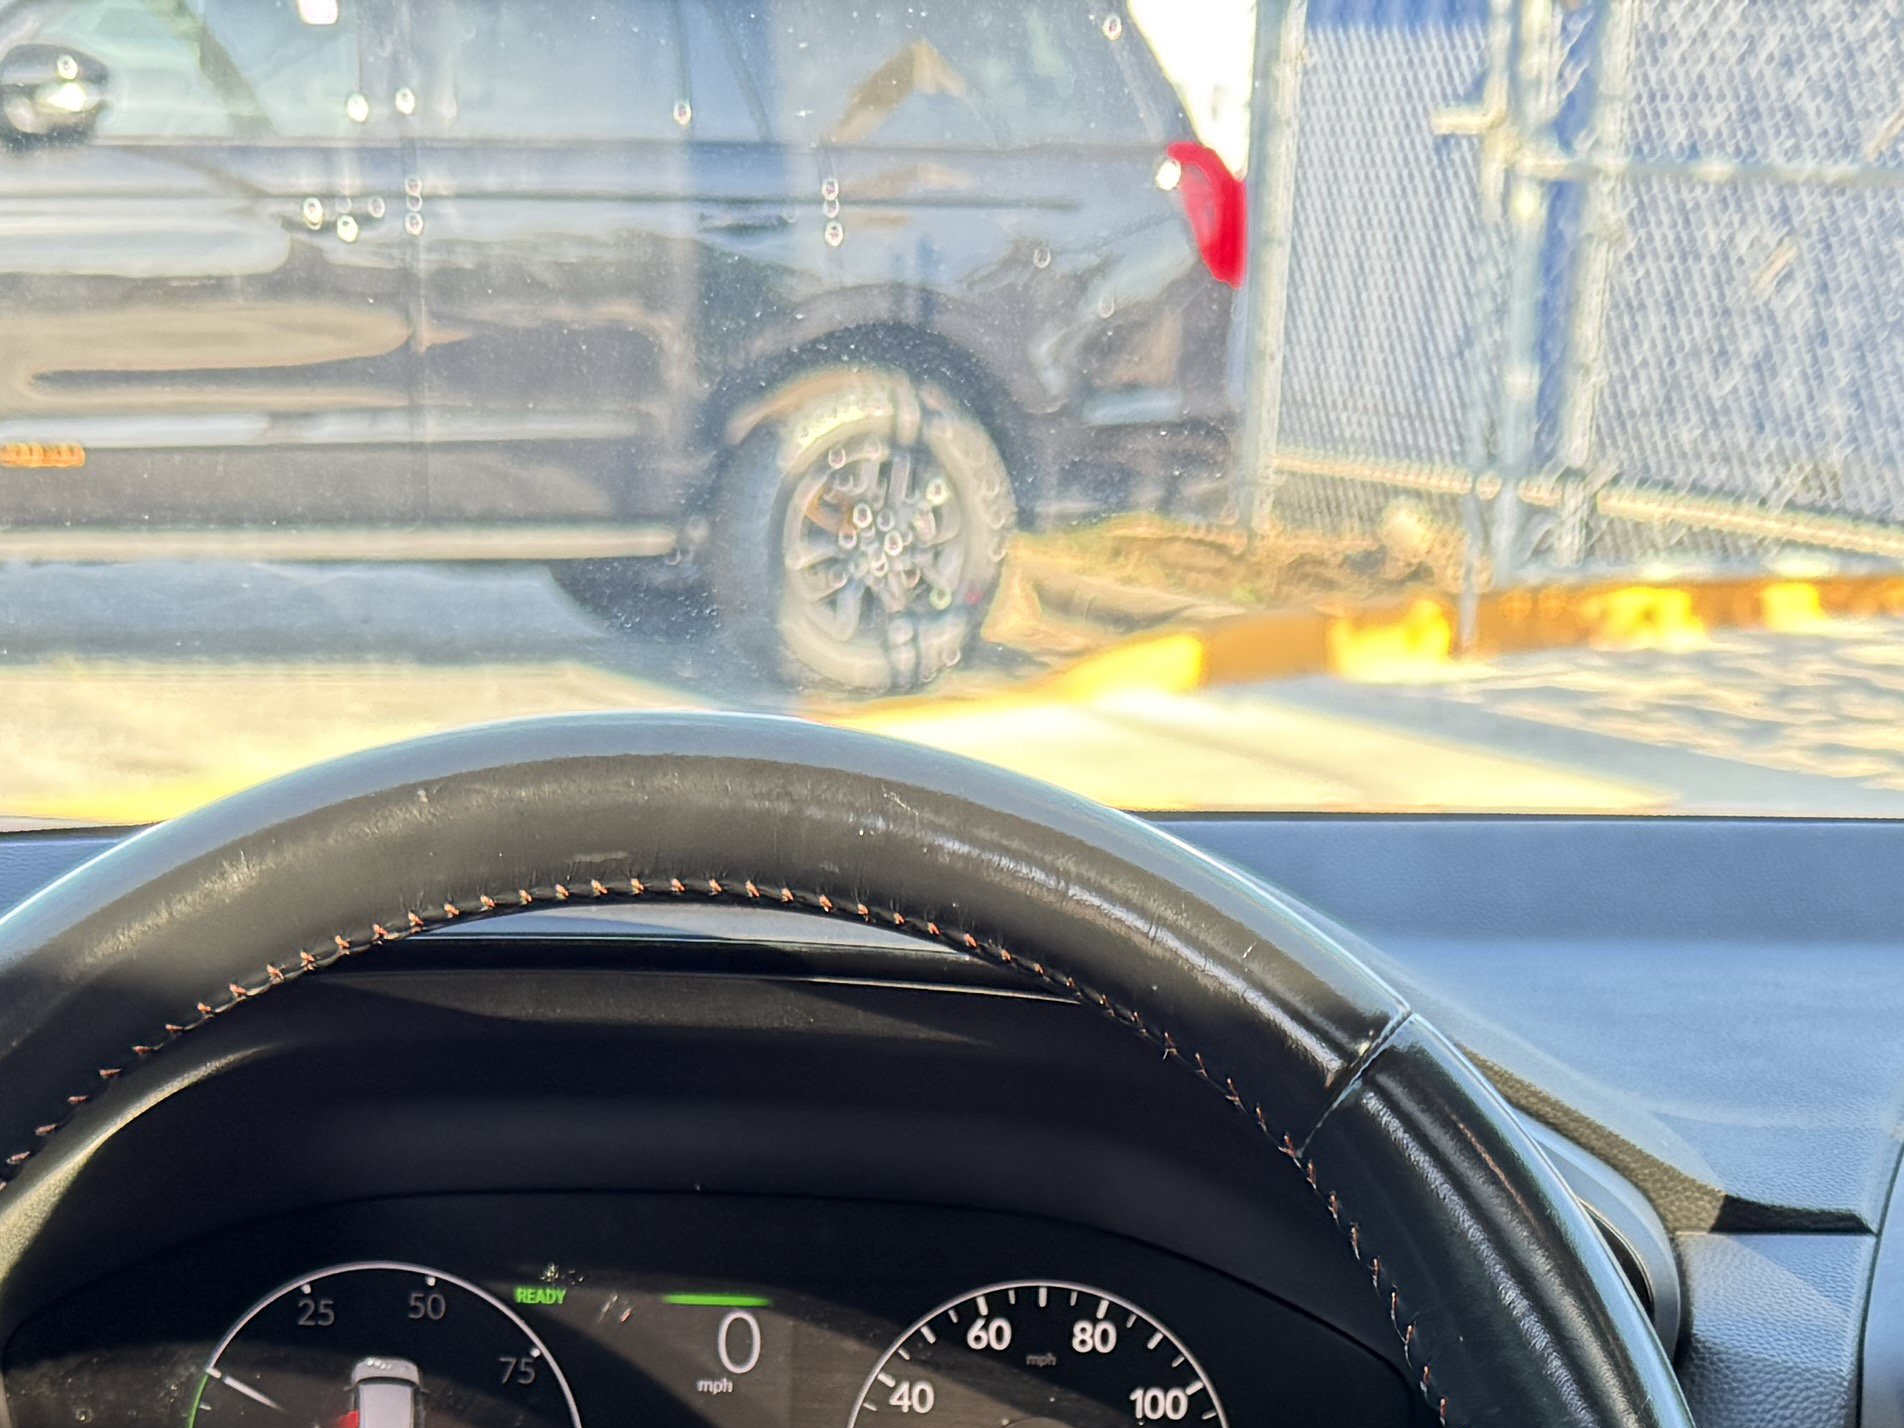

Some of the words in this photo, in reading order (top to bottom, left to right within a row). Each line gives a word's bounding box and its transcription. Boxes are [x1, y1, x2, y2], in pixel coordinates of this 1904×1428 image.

[407, 1293, 447, 1321] 50
[514, 1286, 567, 1305] READY
[297, 1300, 336, 1327] 25
[717, 1310, 762, 1374] 0
[966, 1317, 1012, 1351] 60
[1071, 1319, 1117, 1354] 80
[498, 1356, 536, 1385] 75
[1025, 1353, 1057, 1368] mph
[697, 1377, 733, 1395] mph
[889, 1381, 935, 1414] 40
[1129, 1387, 1189, 1421] 100
